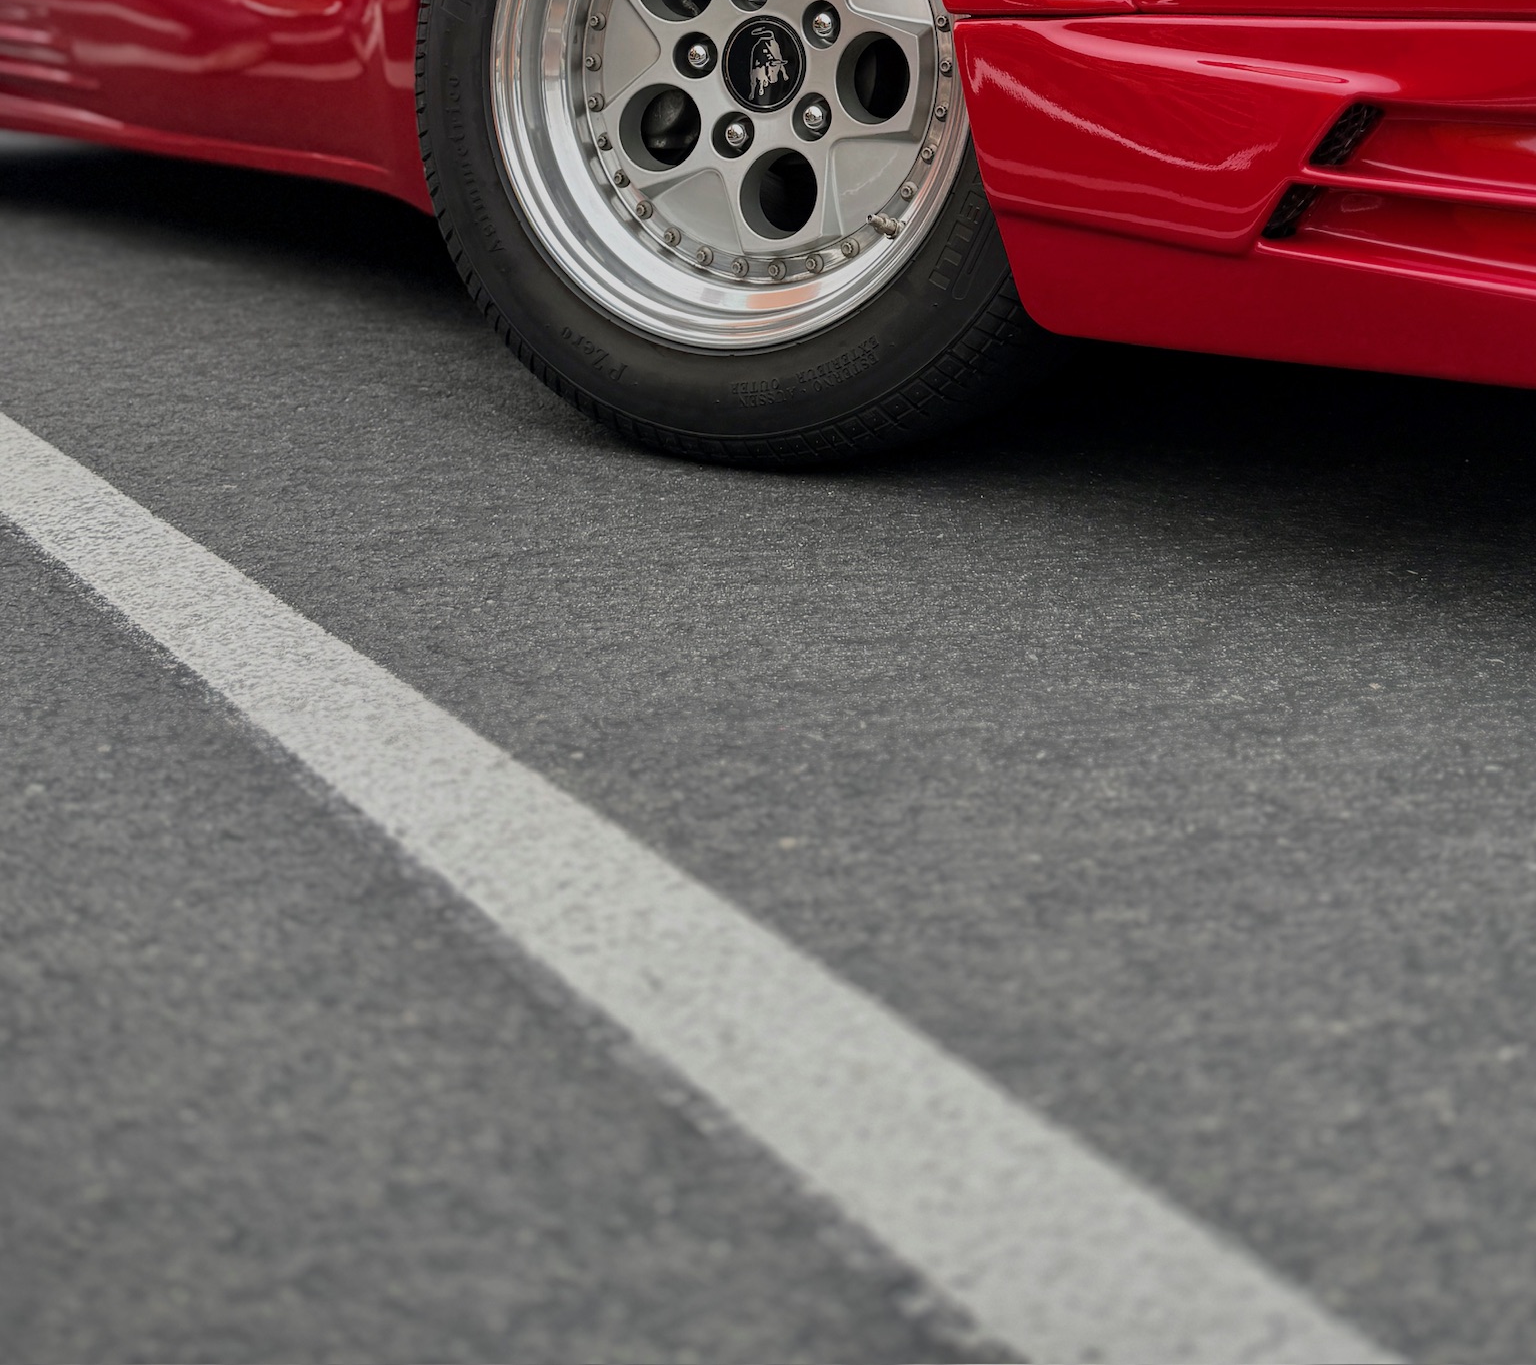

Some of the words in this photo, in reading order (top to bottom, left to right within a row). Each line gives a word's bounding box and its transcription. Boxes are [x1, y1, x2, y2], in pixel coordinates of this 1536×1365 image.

[561, 326, 609, 371] Zero
[796, 335, 880, 383] EXTERIEUR
[609, 363, 628, 381] P
[731, 379, 780, 395] OUTER
[815, 352, 880, 392] ESTERNO
[739, 387, 795, 410] AUSSEN
